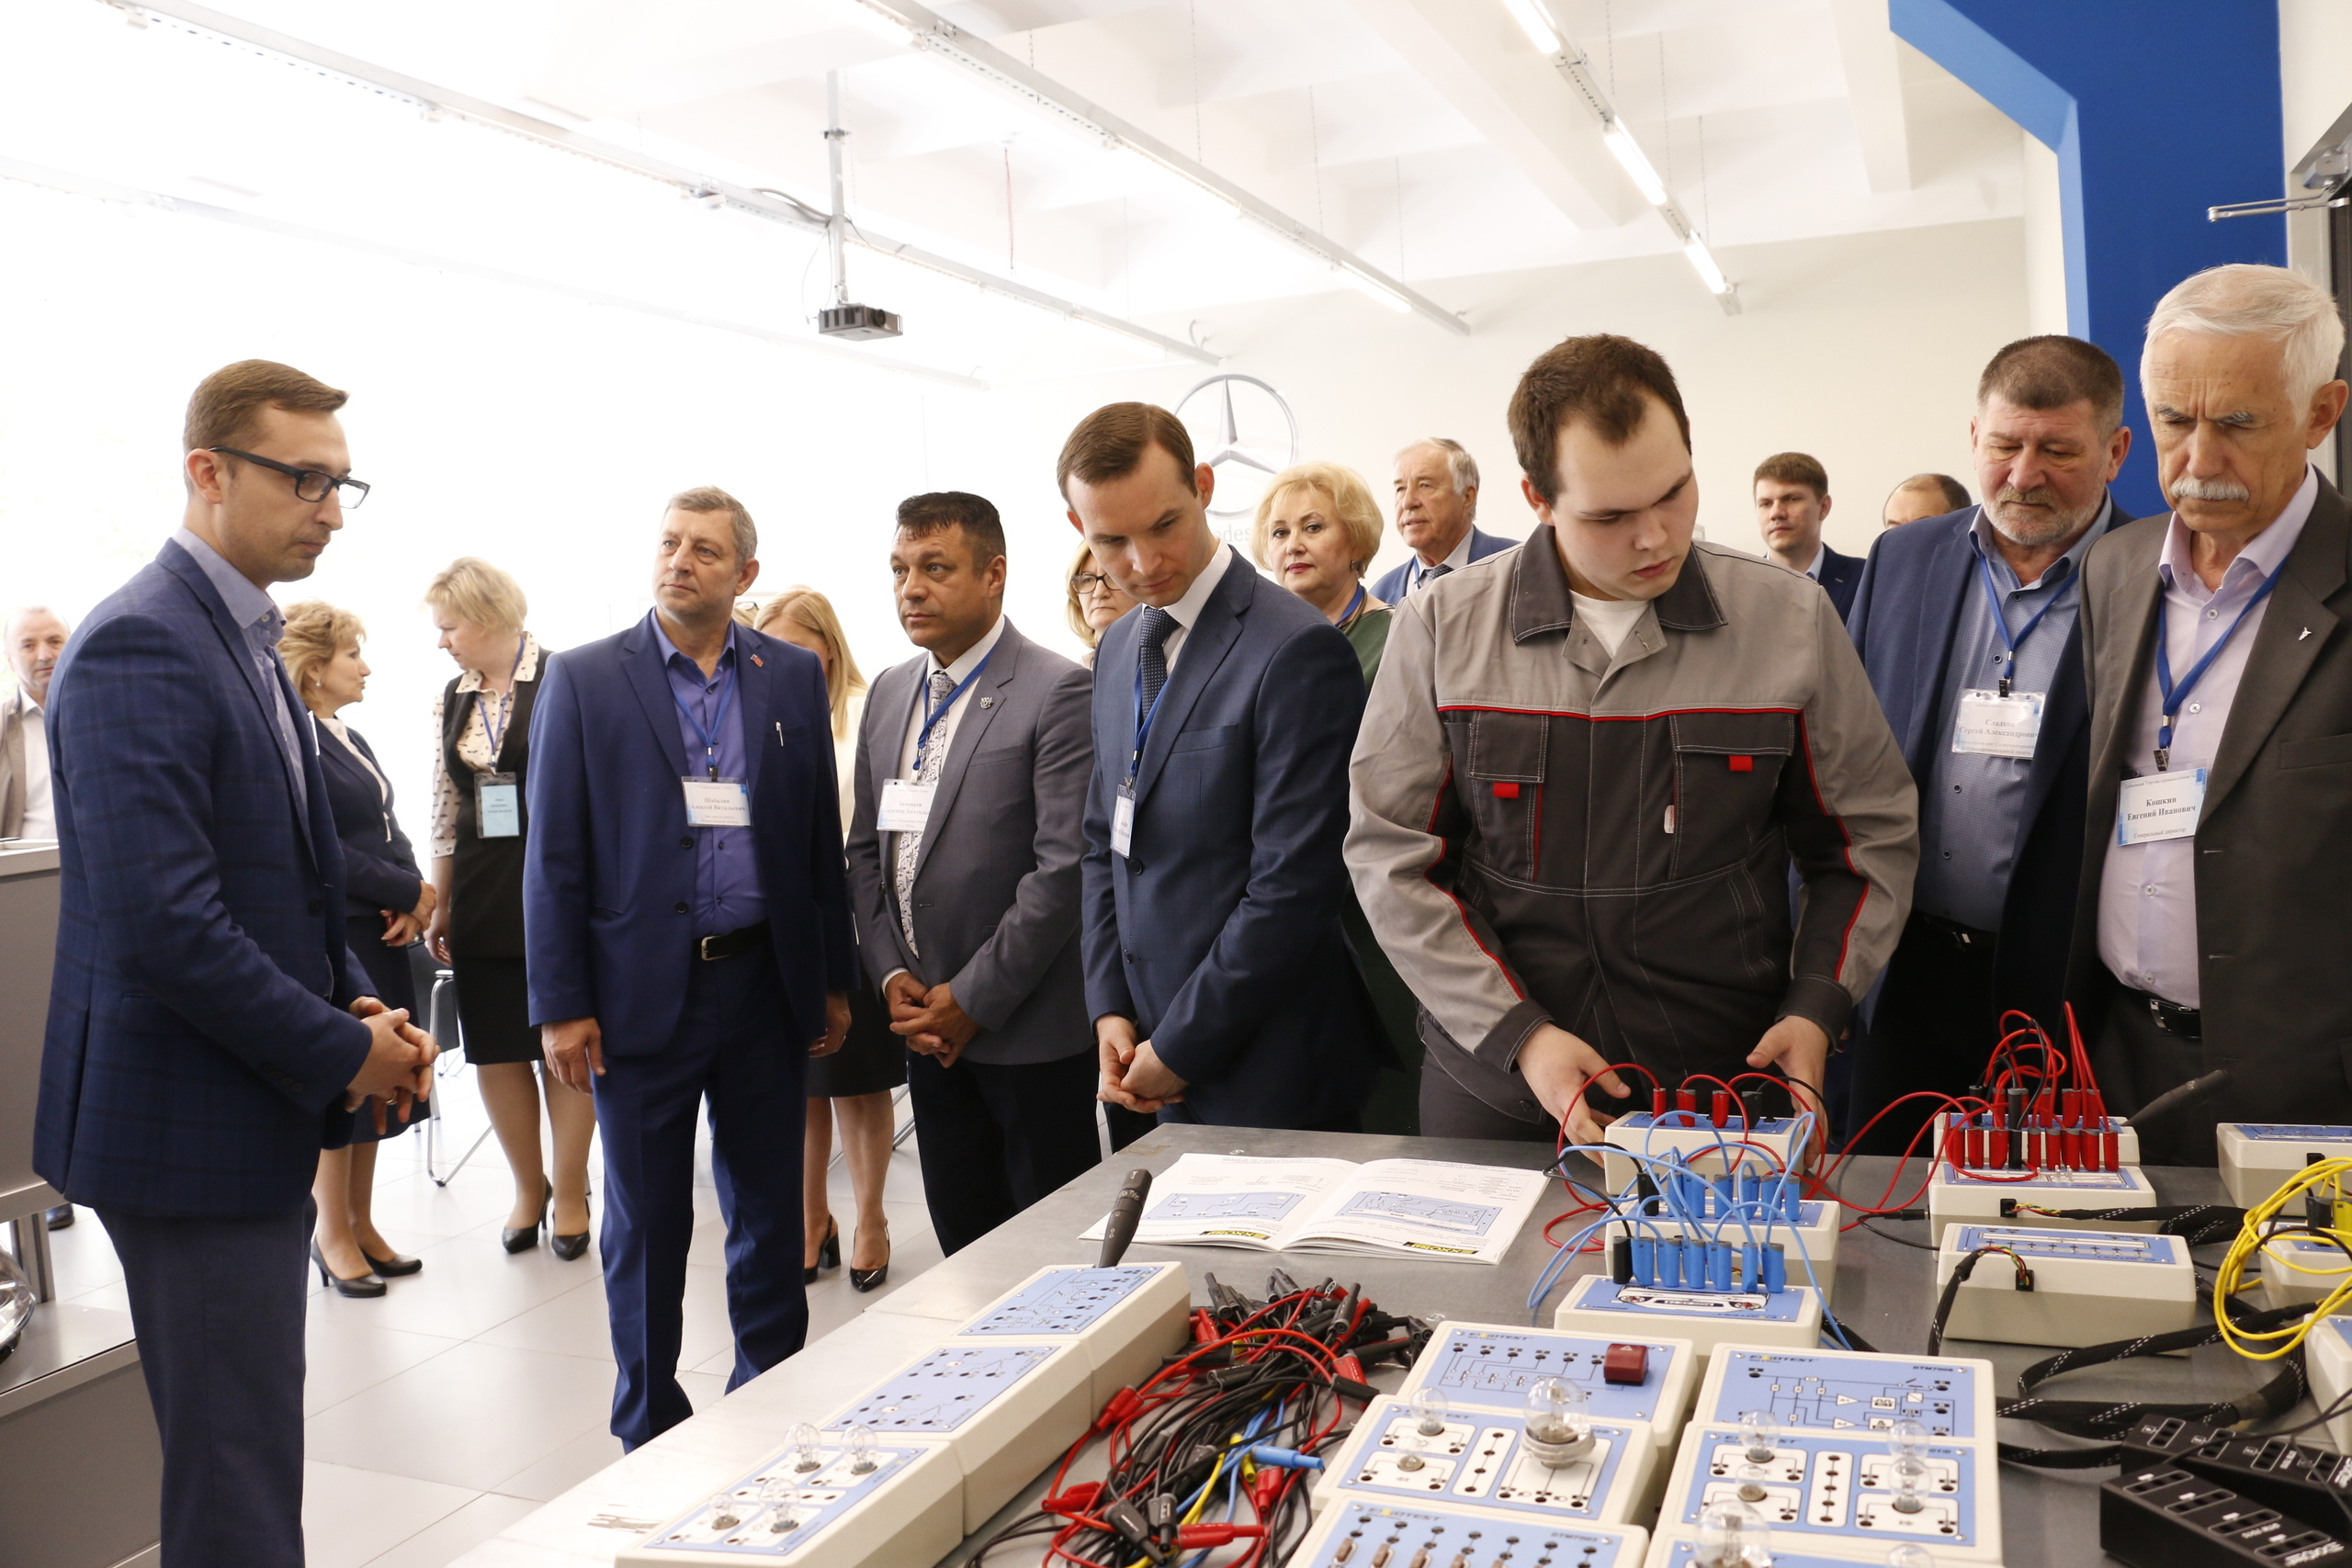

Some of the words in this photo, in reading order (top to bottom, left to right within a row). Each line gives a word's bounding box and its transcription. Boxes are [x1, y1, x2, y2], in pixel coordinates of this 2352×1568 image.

[1959, 727, 1984, 735] Сергей
[2146, 796, 2177, 807] Кошкин
[2127, 808, 2156, 820] Евгений
[2158, 805, 2196, 817] Иванович
[2165, 827, 2187, 836] директор
